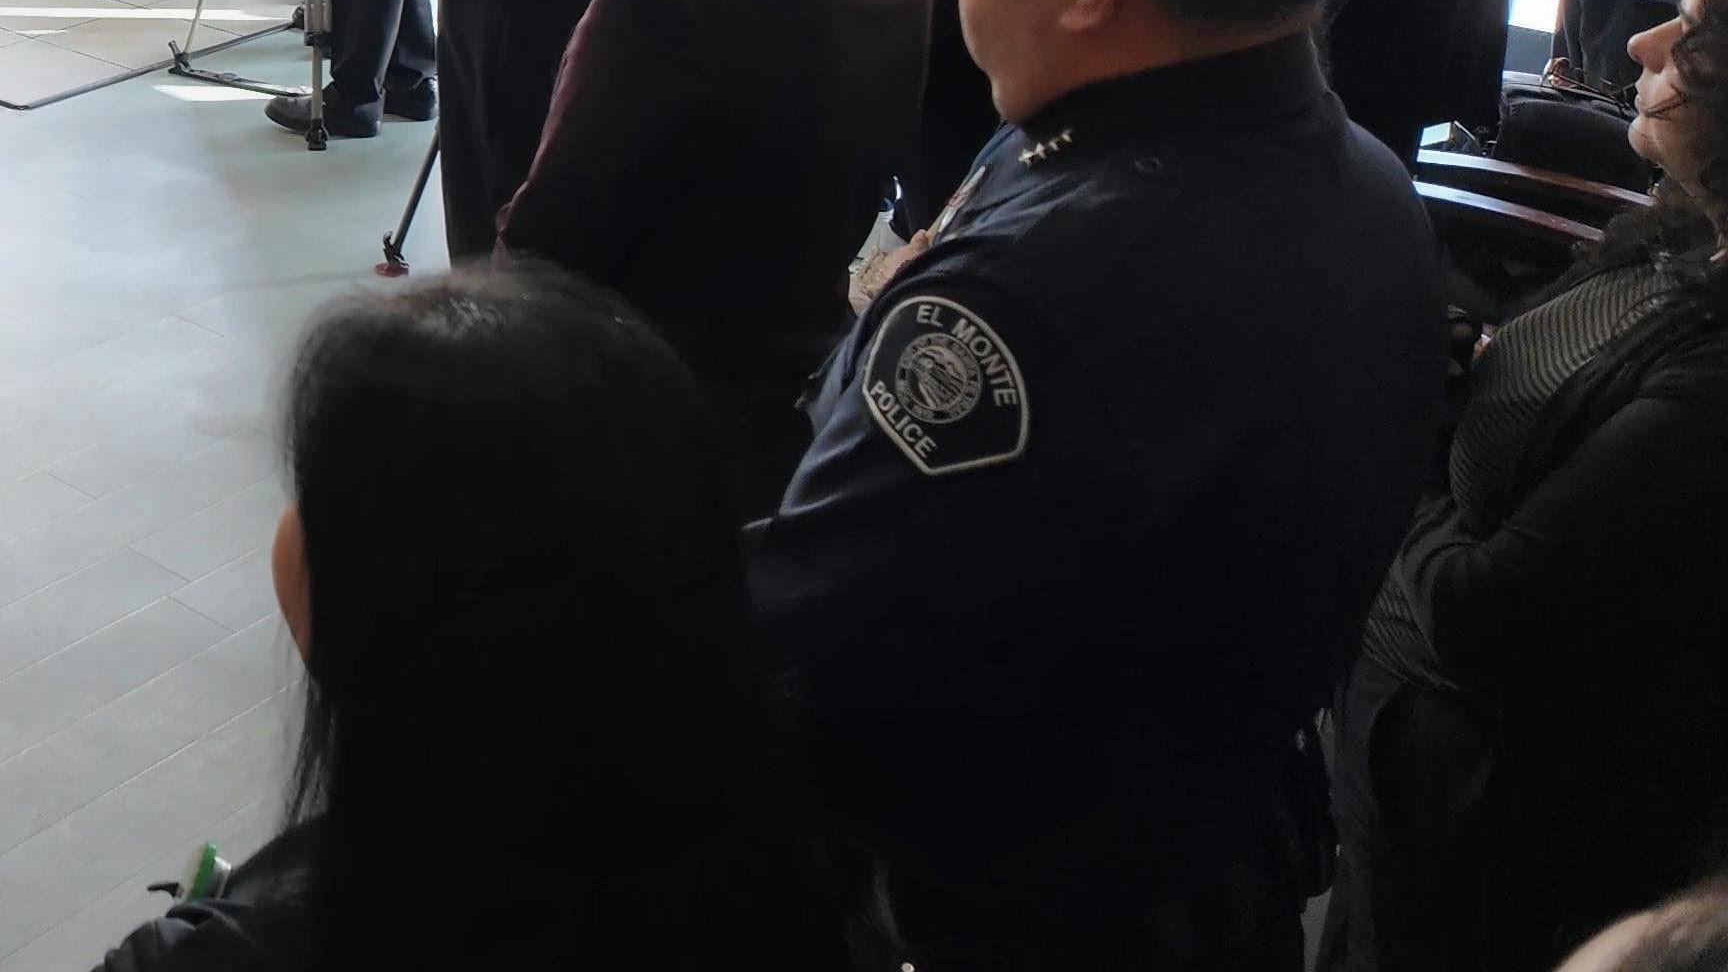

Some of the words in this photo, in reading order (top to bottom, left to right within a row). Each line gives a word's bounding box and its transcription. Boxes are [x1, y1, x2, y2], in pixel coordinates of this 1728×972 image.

[916, 304, 944, 327] EL
[951, 317, 1017, 407] MONTE
[870, 380, 939, 459] POLICE
